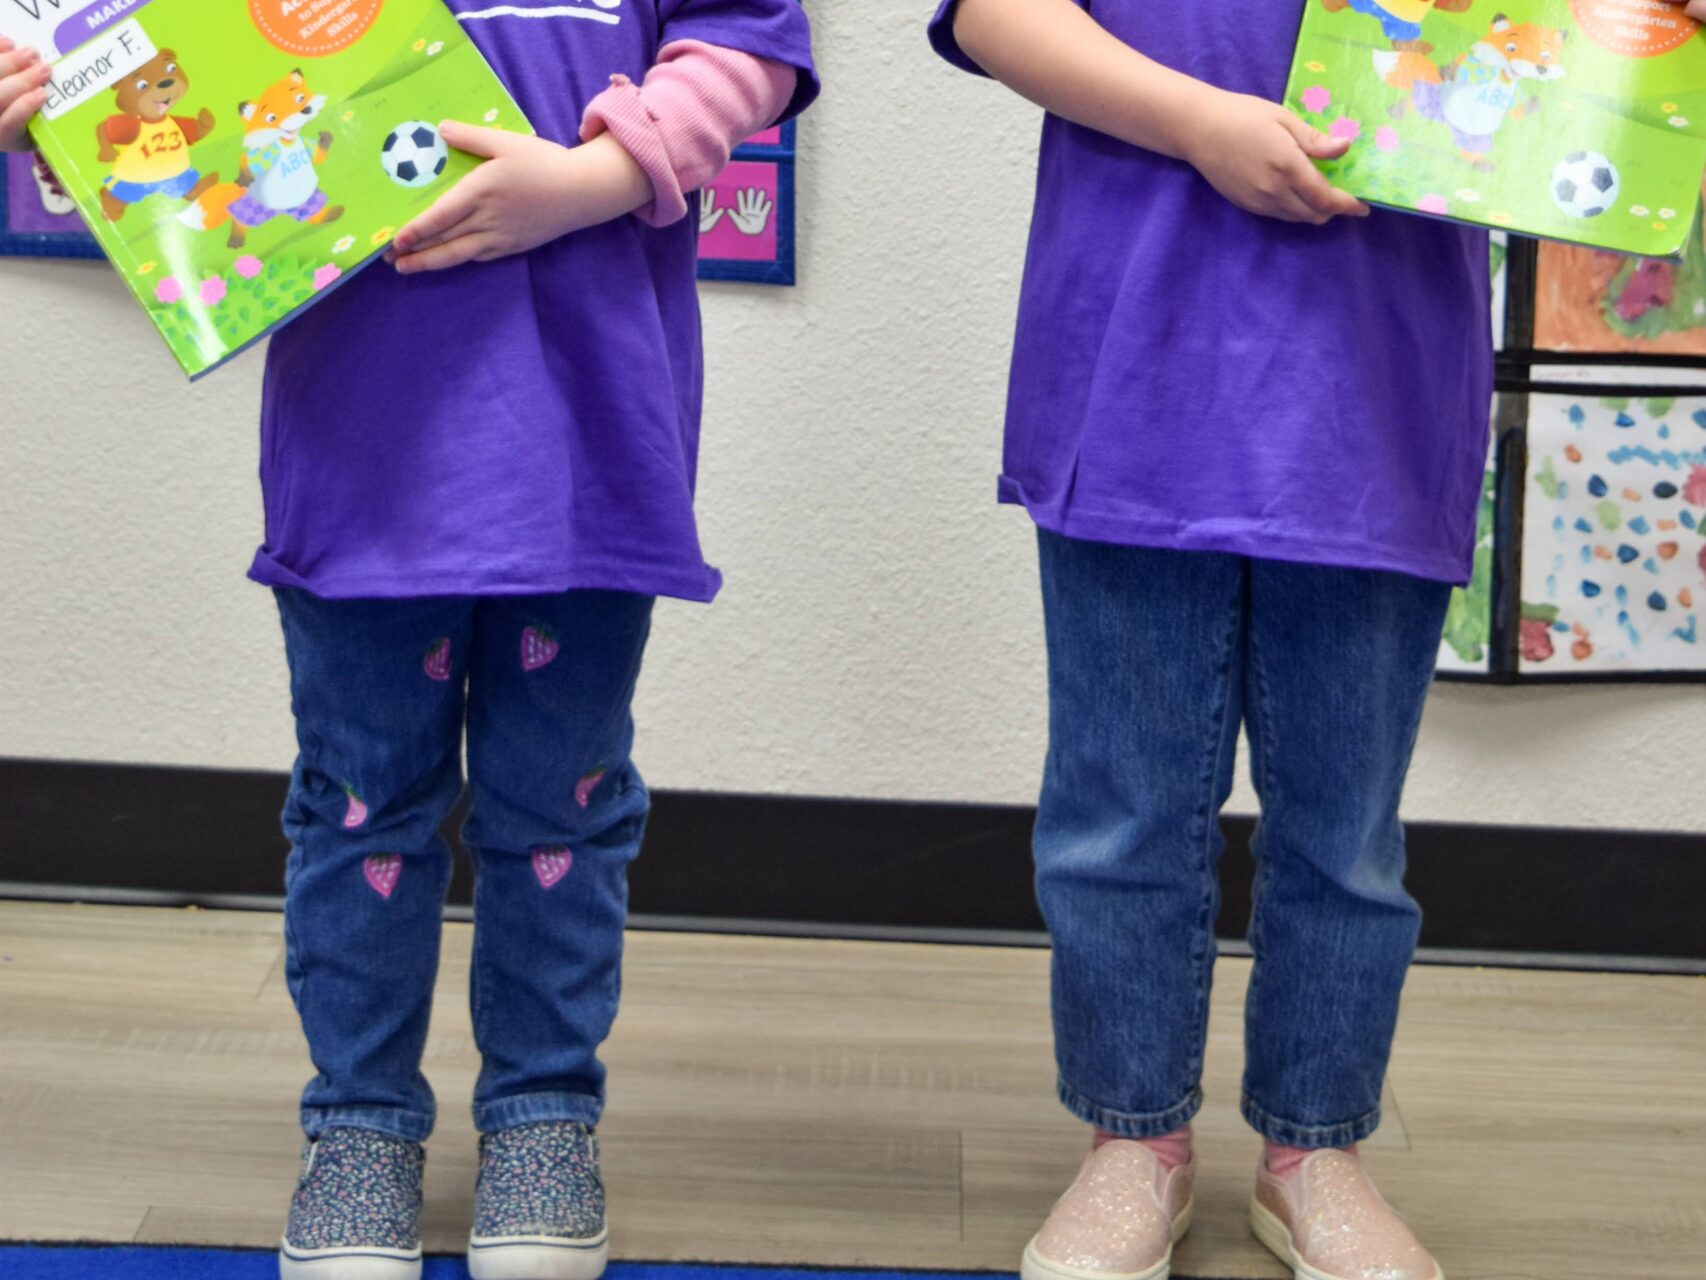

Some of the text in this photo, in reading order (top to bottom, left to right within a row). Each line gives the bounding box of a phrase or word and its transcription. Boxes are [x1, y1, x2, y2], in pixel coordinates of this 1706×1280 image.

[326, 11, 359, 37] Skills
[117, 29, 142, 56] F.
[140, 131, 182, 160] 123
